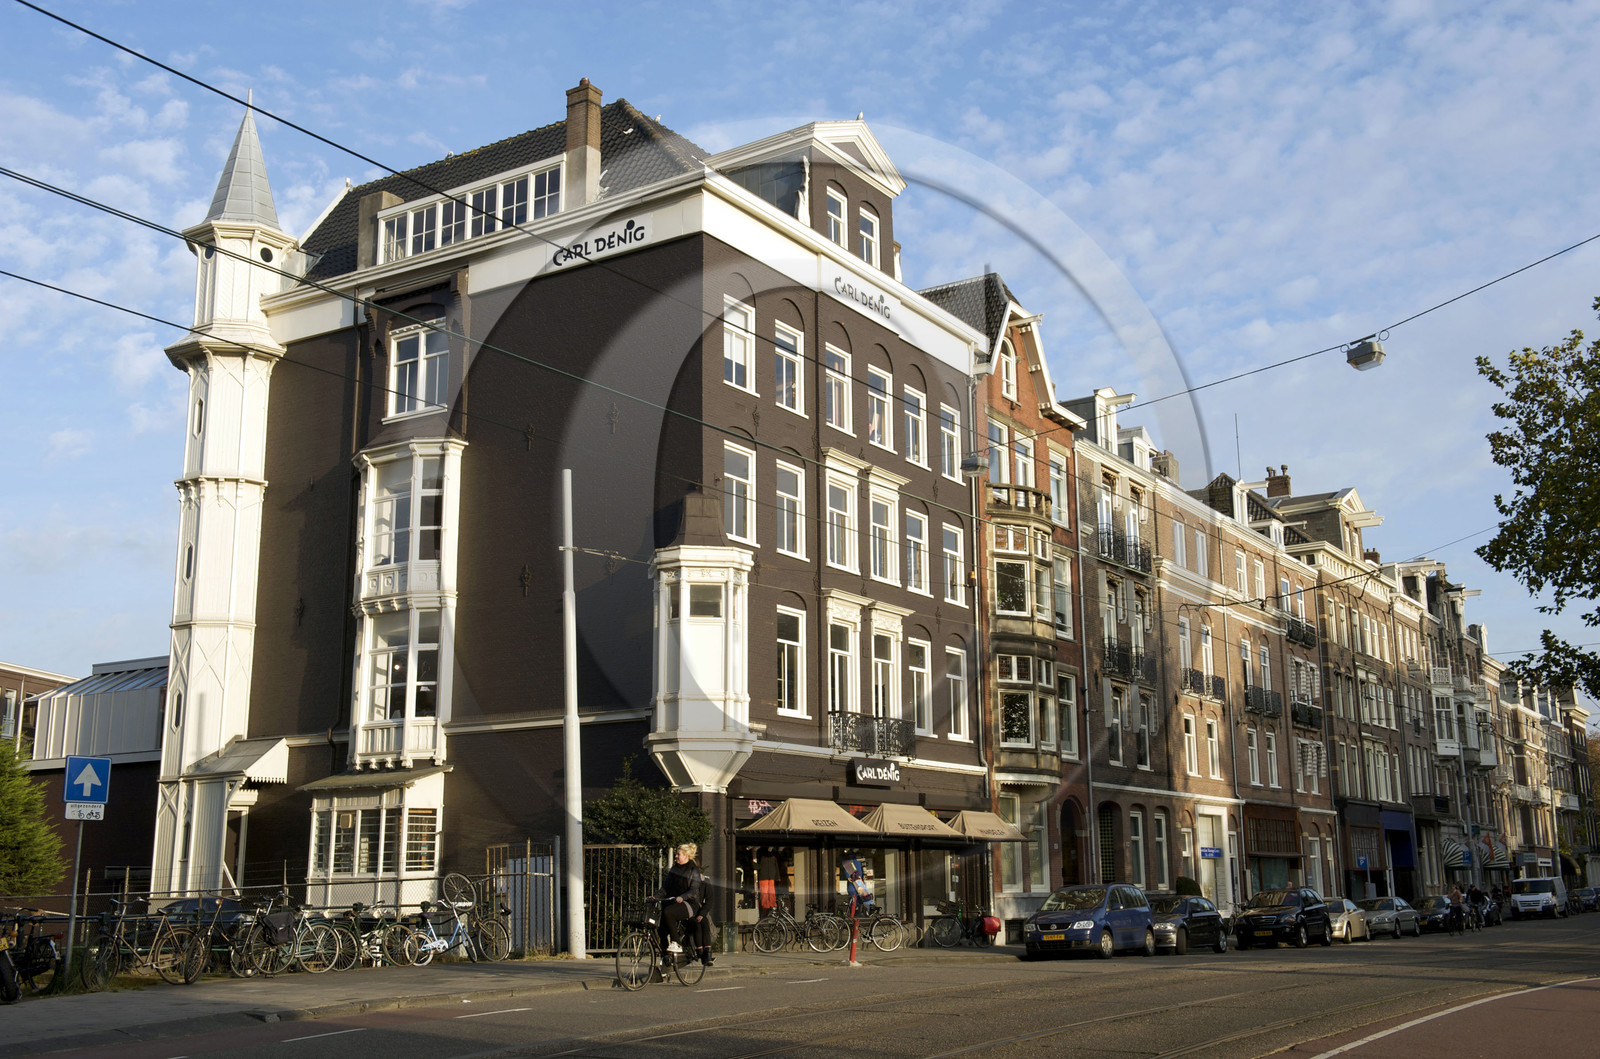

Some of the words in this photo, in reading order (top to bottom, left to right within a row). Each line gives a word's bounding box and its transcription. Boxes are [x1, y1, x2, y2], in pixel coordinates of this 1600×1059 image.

[553, 242, 591, 266] CARL
[835, 276, 859, 302] CARL
[857, 764, 877, 781] CARL
[811, 819, 838, 827] REIZEN
